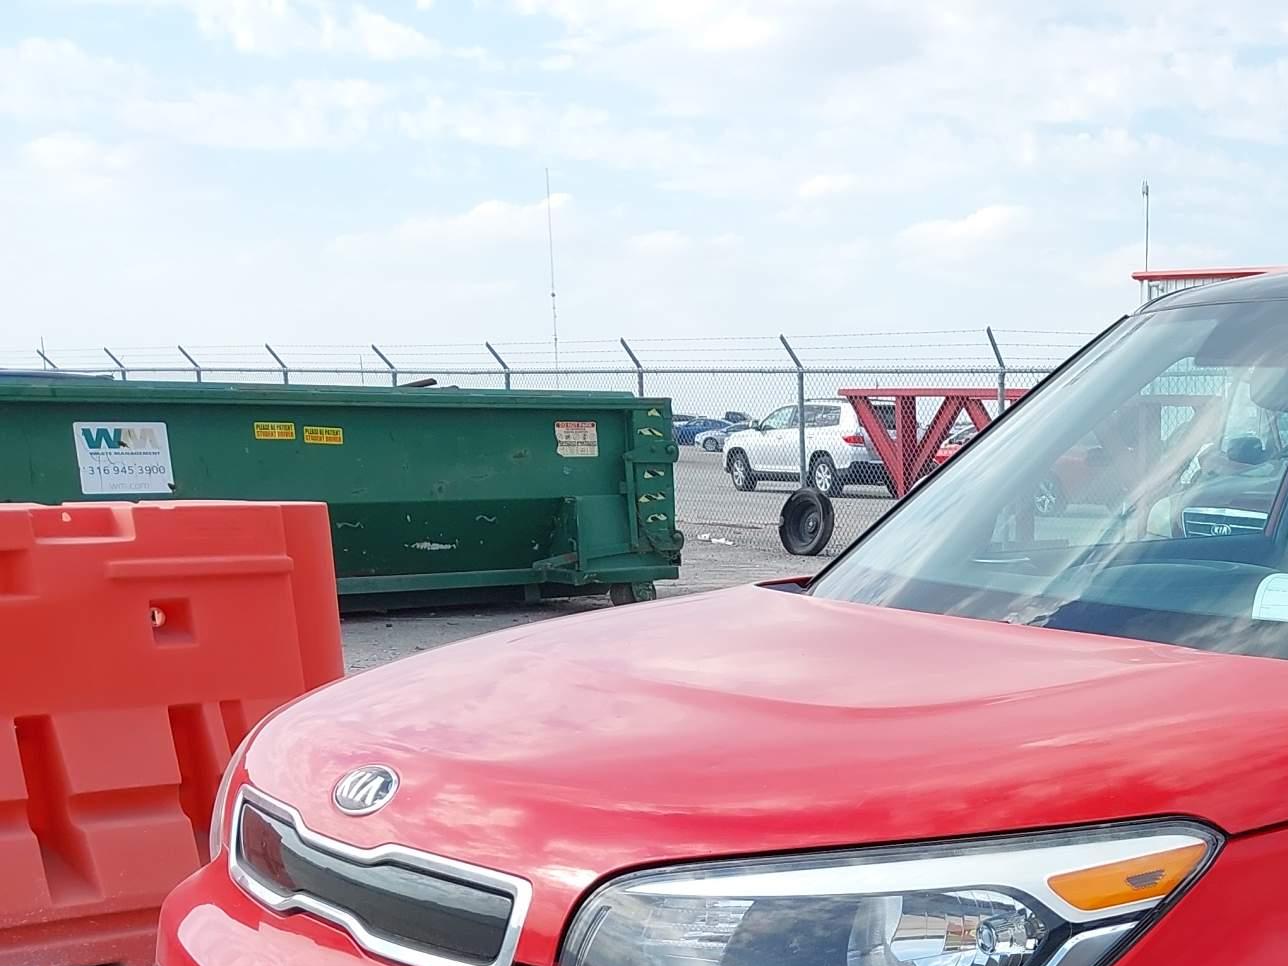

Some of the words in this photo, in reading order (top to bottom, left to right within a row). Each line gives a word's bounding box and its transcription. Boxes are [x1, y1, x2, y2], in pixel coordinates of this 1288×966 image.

[82, 428, 160, 449] WM
[88, 465, 110, 475] 316
[112, 465, 134, 475] 945
[138, 465, 166, 475] 3900
